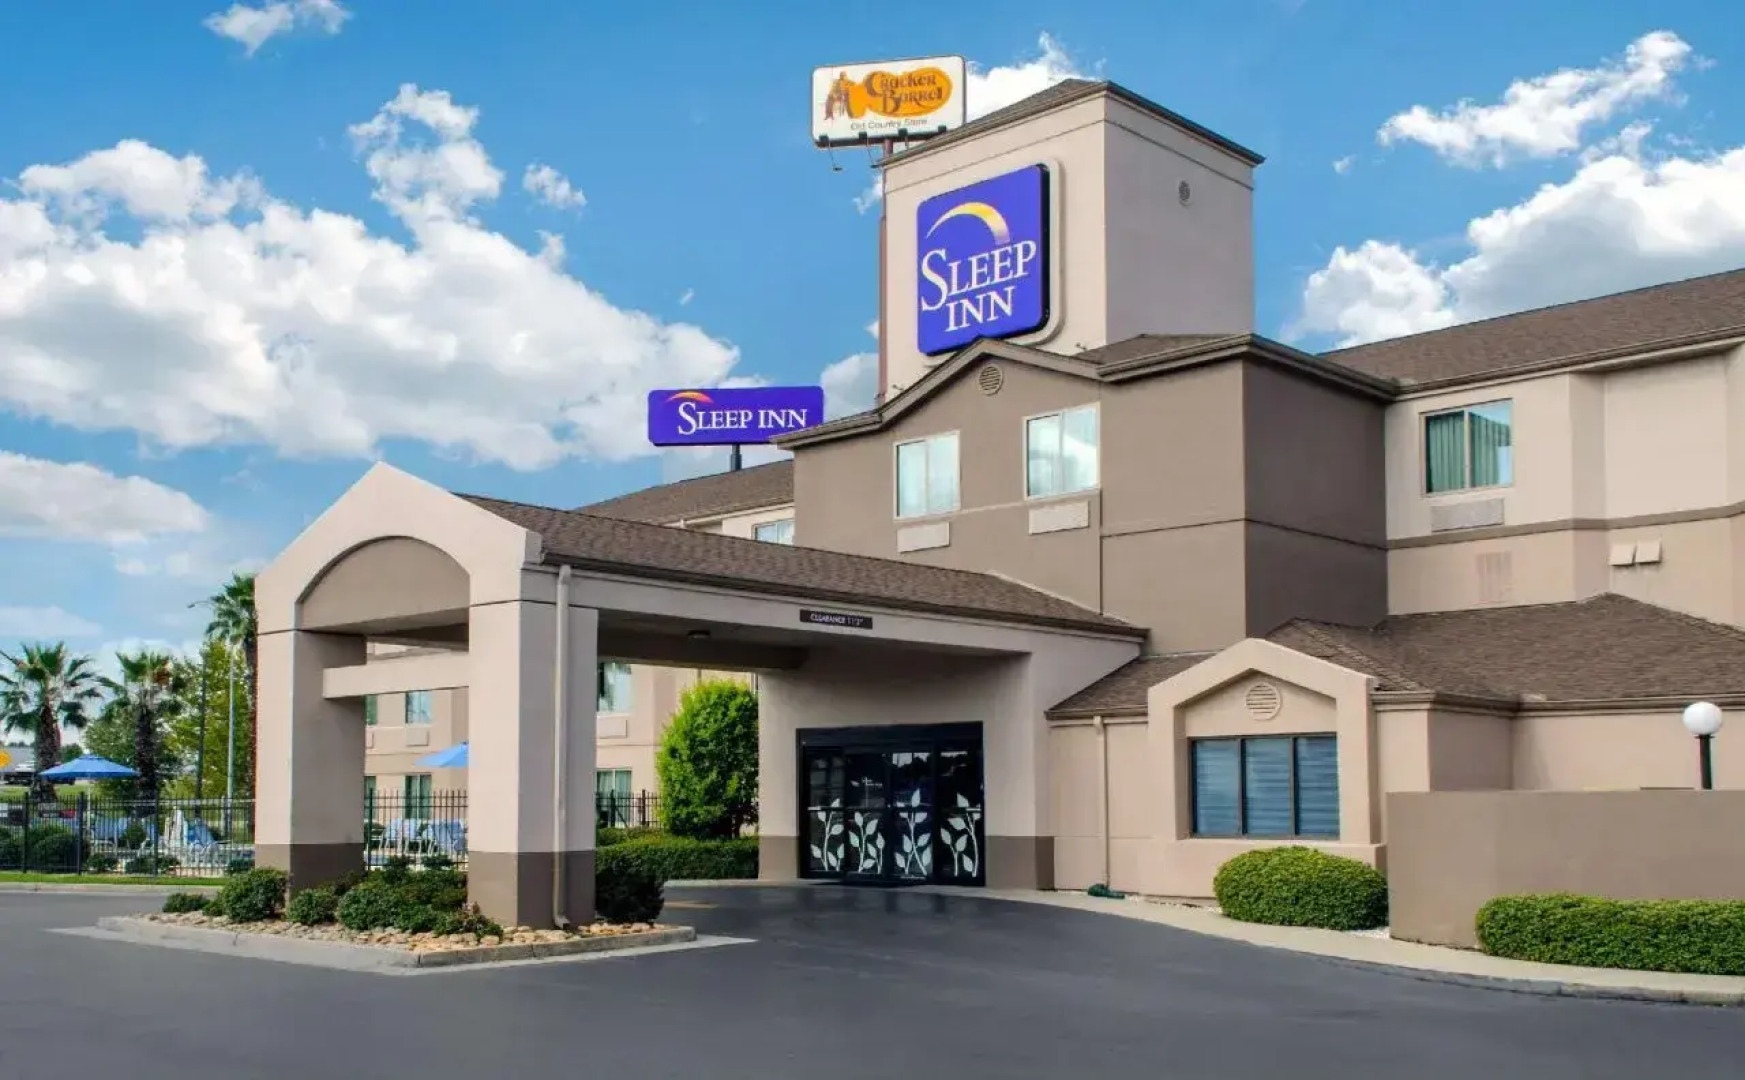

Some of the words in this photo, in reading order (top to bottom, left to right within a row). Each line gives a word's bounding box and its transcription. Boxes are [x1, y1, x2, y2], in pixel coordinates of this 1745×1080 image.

[850, 121, 865, 131] Old
[868, 119, 901, 129] Country
[921, 240, 1037, 311] SLEEP
[945, 285, 1016, 332] INN
[678, 401, 753, 435] SLEEP
[758, 409, 808, 429] INN
[810, 613, 846, 624] CLEARANCE
